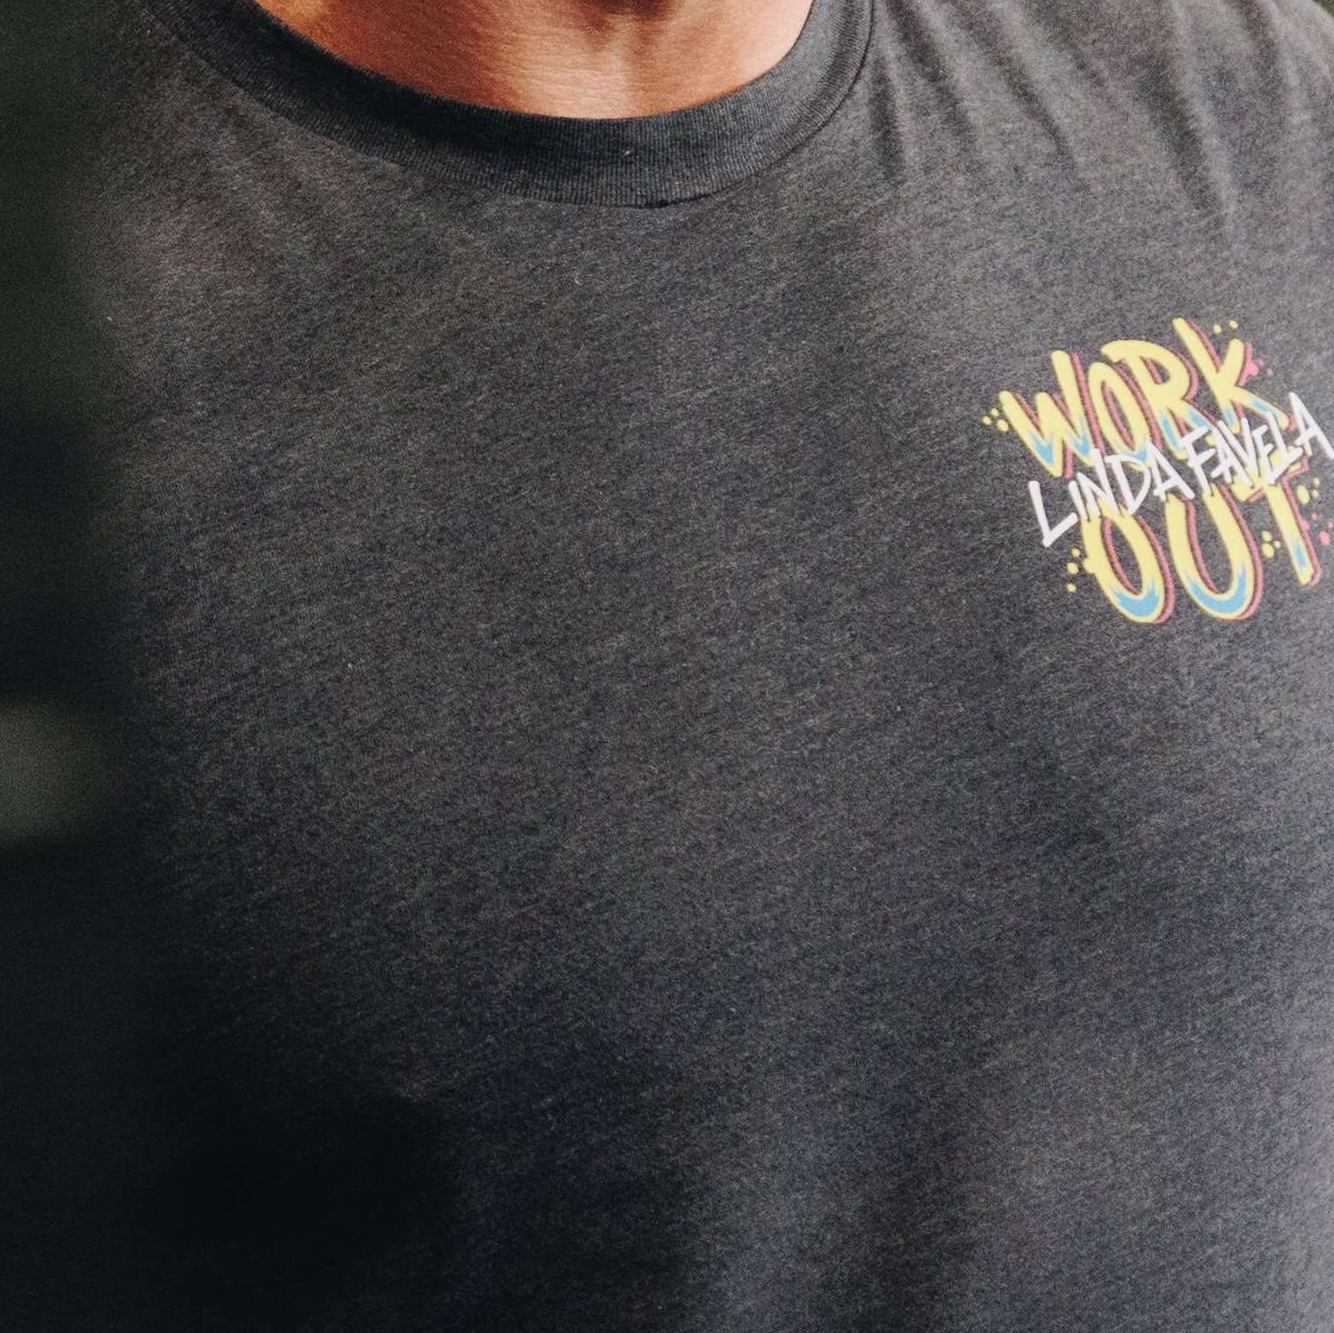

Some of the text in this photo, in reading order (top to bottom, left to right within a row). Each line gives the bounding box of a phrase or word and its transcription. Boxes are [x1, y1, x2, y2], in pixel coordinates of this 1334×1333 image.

[999, 317, 1296, 478] WORK
[1028, 441, 1195, 547] LINDA
[1080, 445, 1321, 624] OUT
